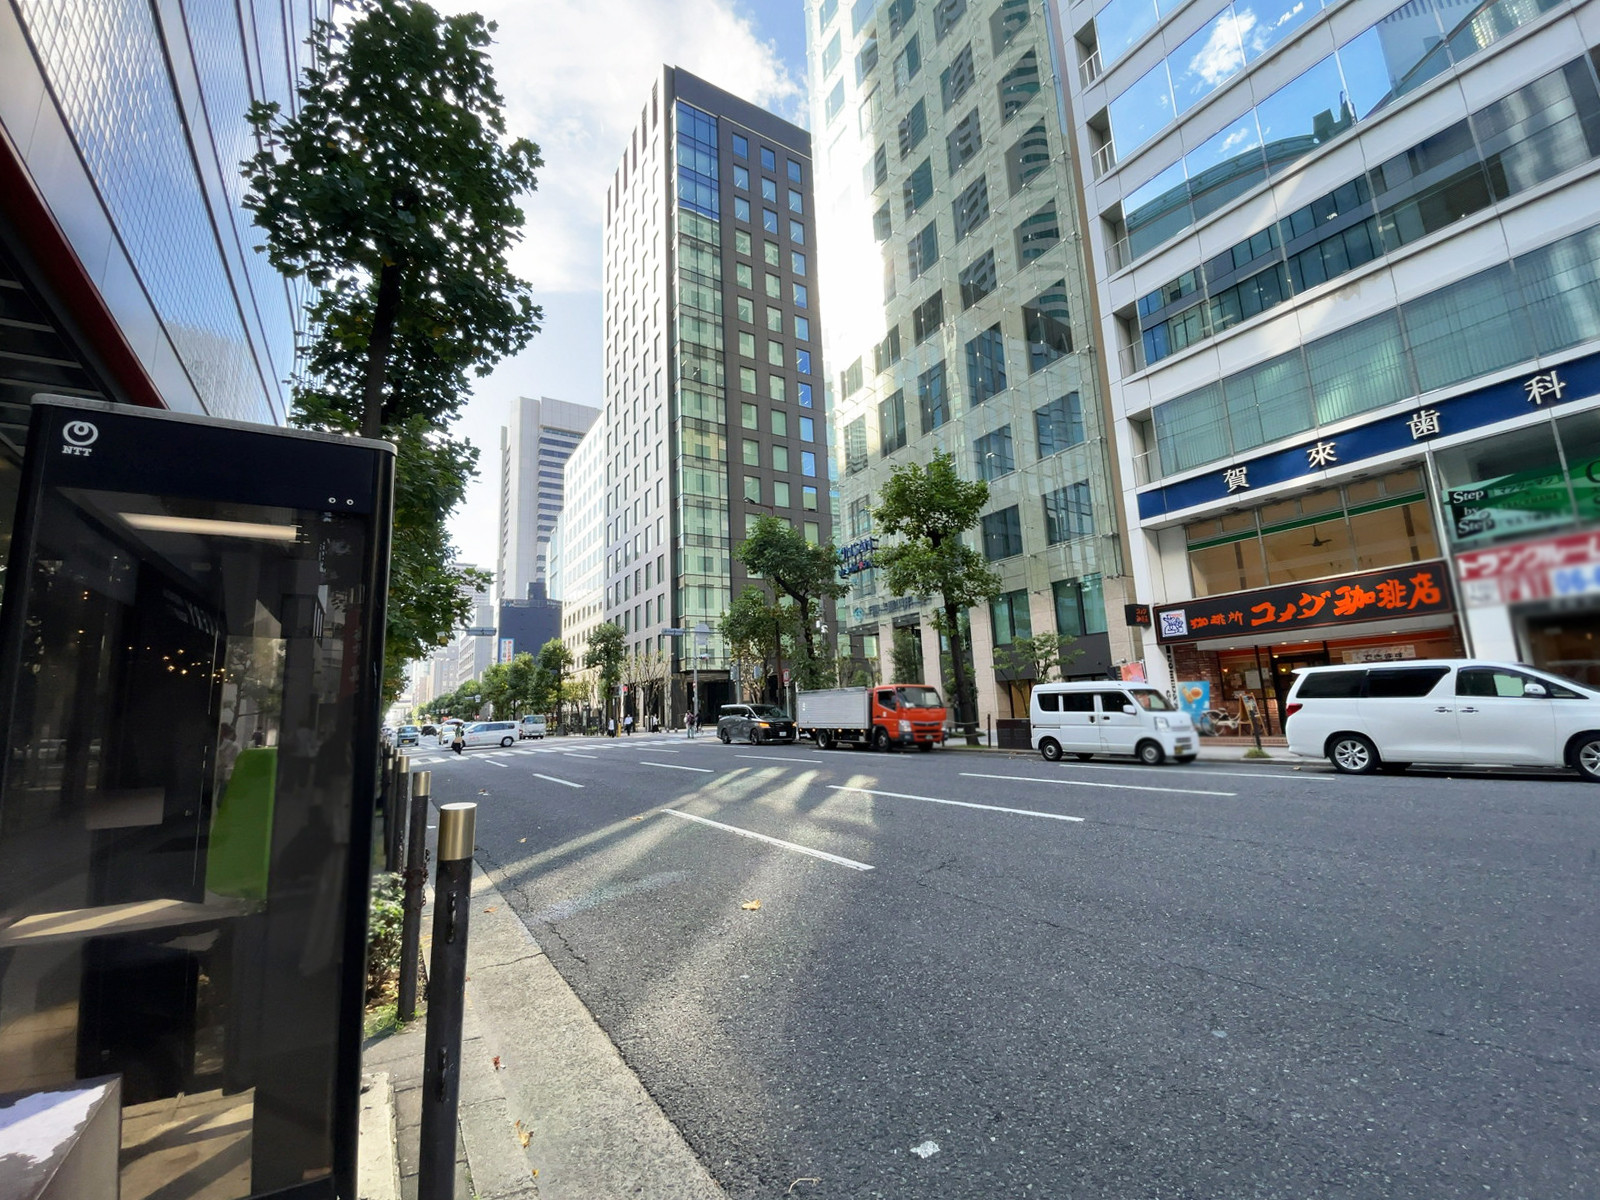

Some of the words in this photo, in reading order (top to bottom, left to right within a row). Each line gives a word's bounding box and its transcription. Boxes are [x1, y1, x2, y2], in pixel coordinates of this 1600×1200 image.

[61, 445, 92, 457] NTT
[1453, 490, 1484, 504] Step
[1457, 518, 1492, 535] Step
[1250, 572, 1441, 627] コメダ珈琲店
